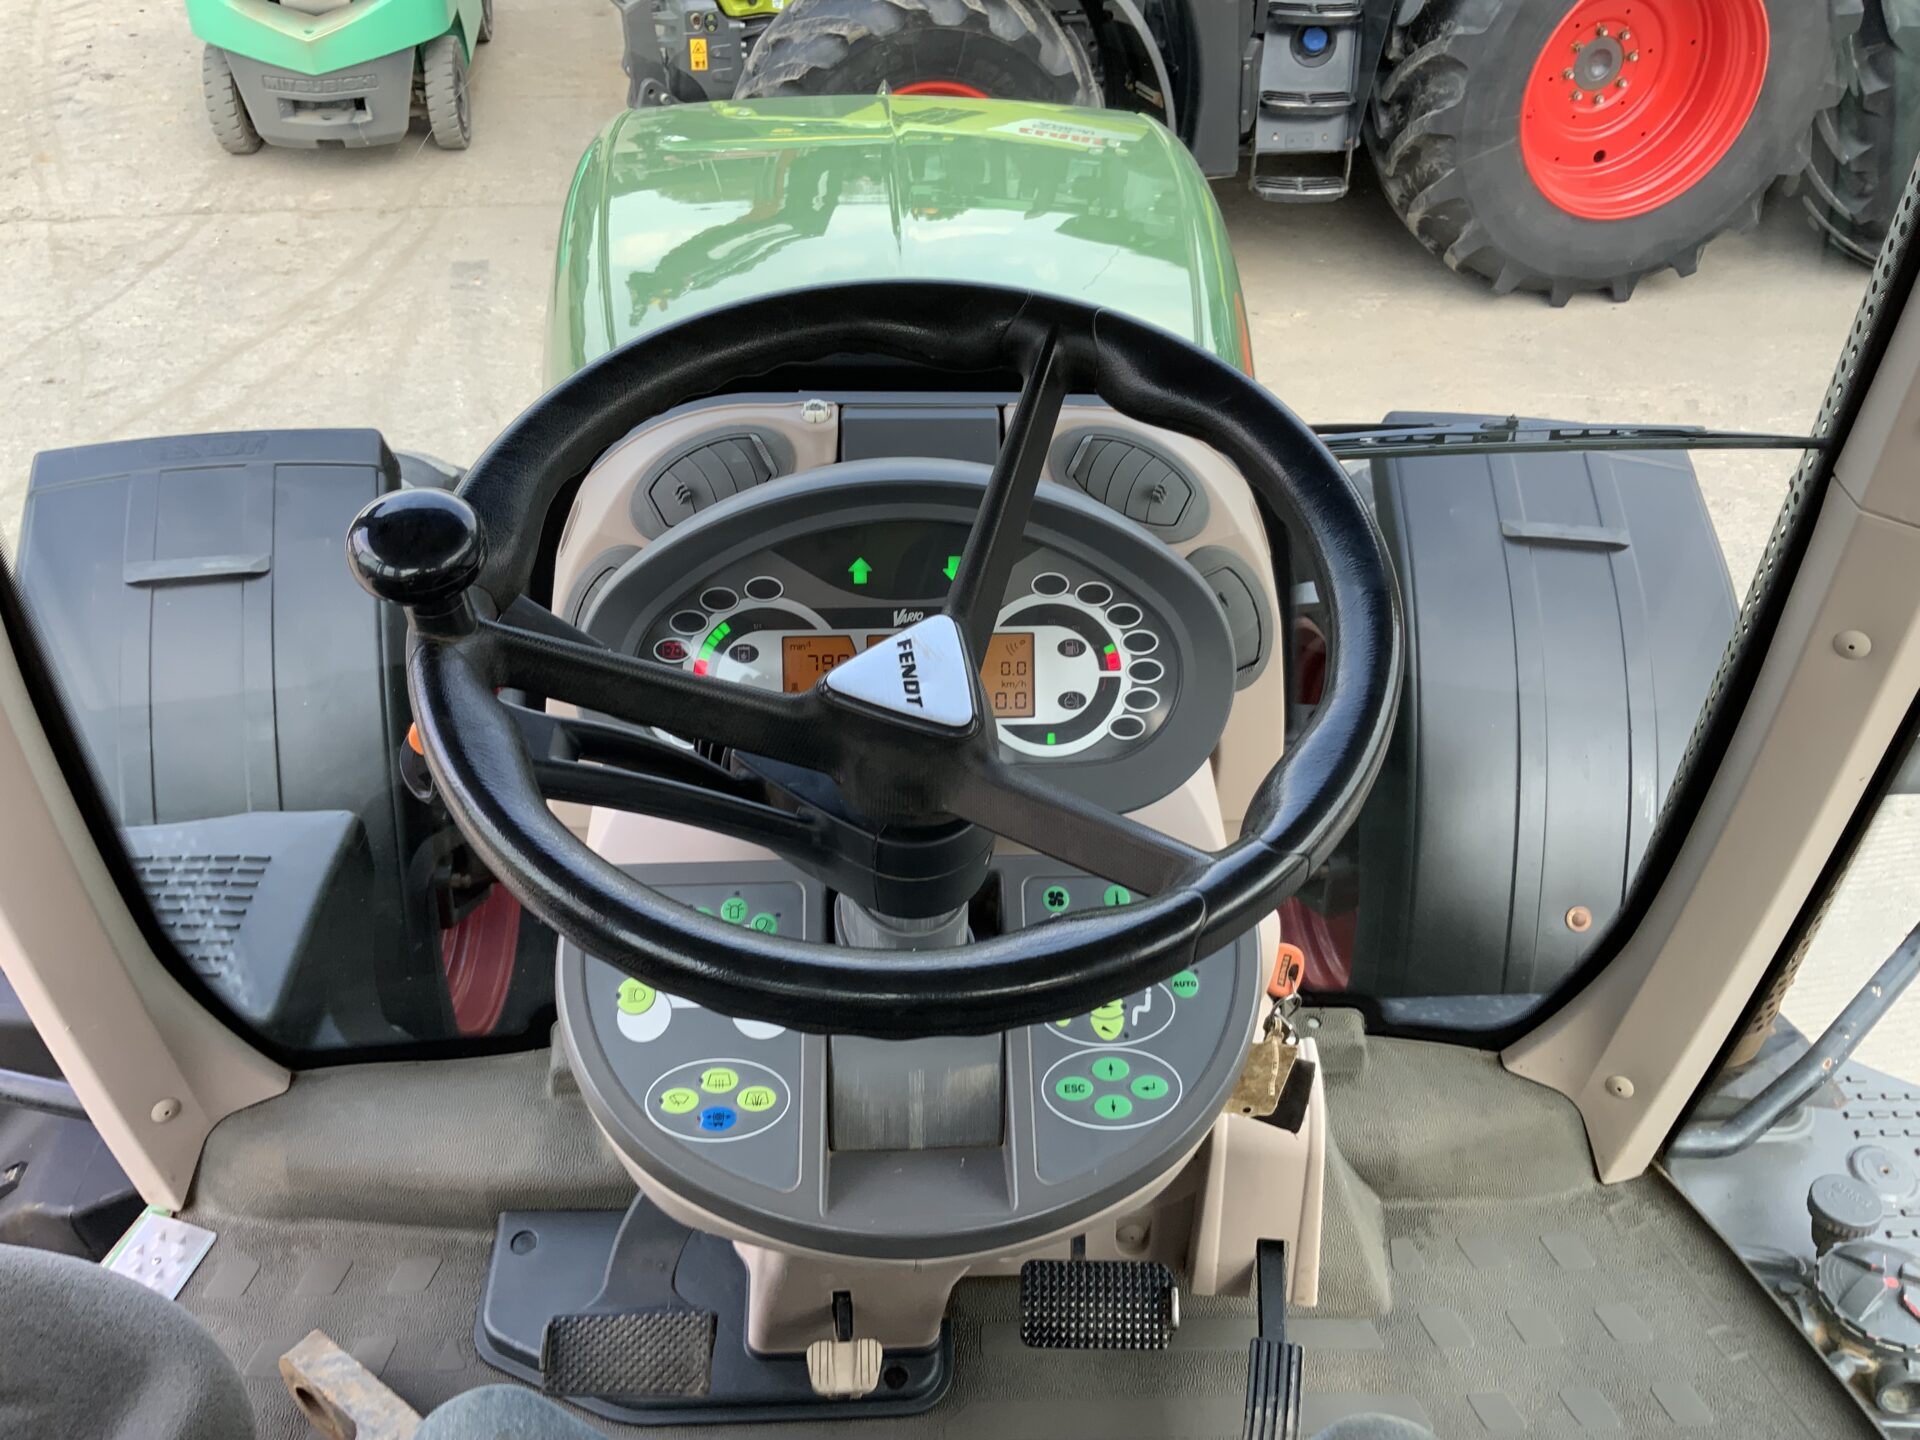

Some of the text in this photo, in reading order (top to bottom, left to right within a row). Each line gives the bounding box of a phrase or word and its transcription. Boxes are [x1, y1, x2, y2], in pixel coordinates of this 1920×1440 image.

[893, 608, 924, 627] VARIO
[897, 638, 923, 708] FENDT
[1000, 661, 1027, 676] 0.0
[1001, 680, 1027, 689] km/h
[995, 691, 1027, 710] 0.0
[1173, 980, 1197, 988] AUTO
[1064, 1084, 1086, 1094] ESC
